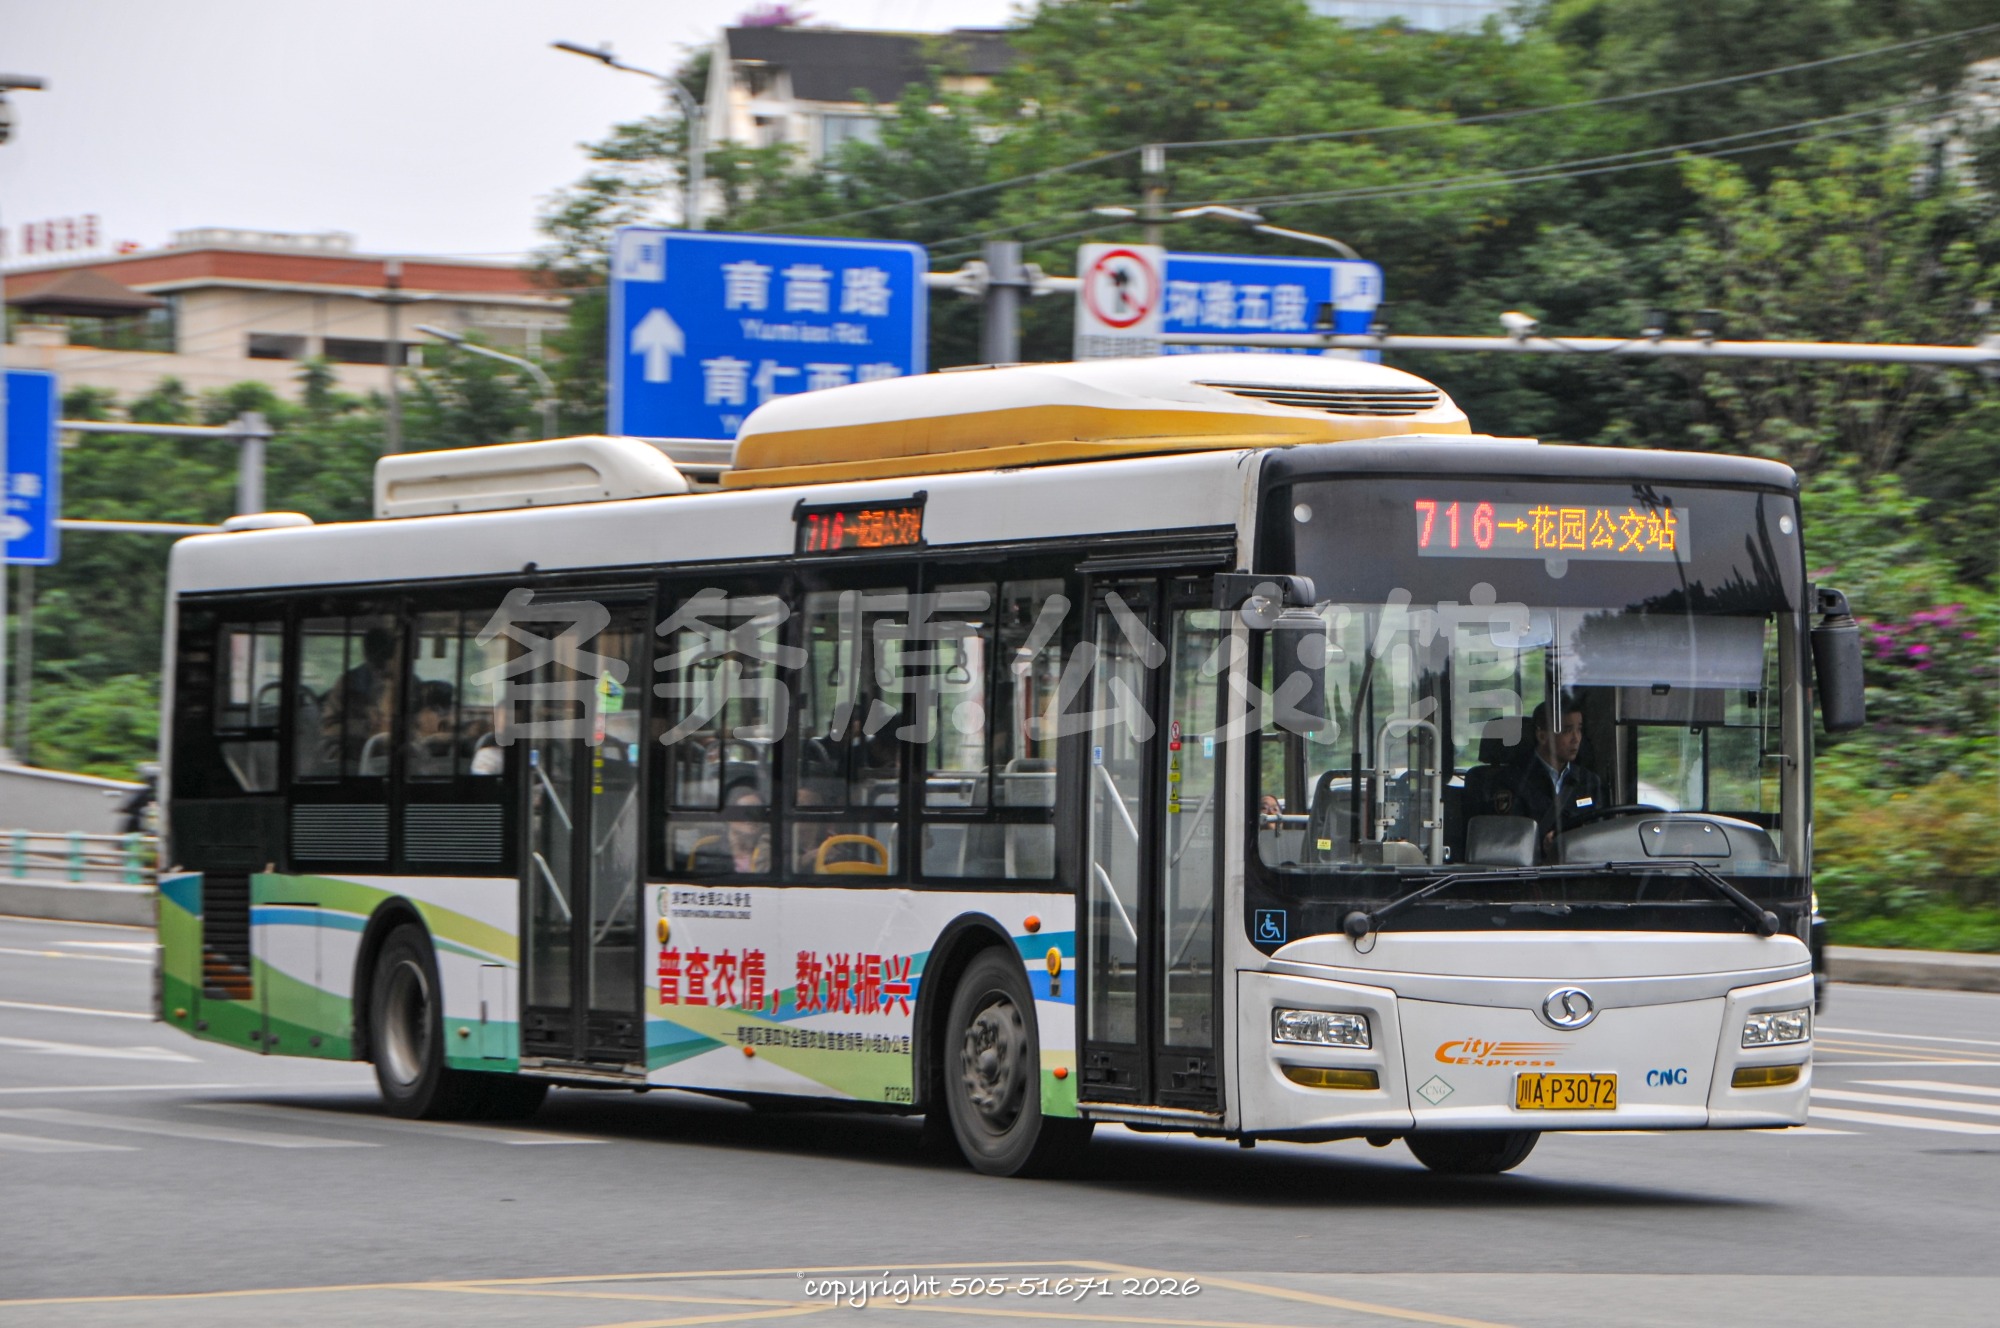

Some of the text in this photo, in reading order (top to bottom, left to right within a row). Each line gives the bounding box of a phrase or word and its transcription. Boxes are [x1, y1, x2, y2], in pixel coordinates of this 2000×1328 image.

[720, 260, 892, 317] 育苗路
[1415, 500, 1678, 552] 716 花园公交站
[657, 946, 912, 1016] 普查农情，数说振兴
[1434, 1037, 1497, 1065] City
[1455, 1057, 1557, 1067] Express
[1425, 1084, 1447, 1096] CNG
[1646, 1068, 1688, 1087] CNG
